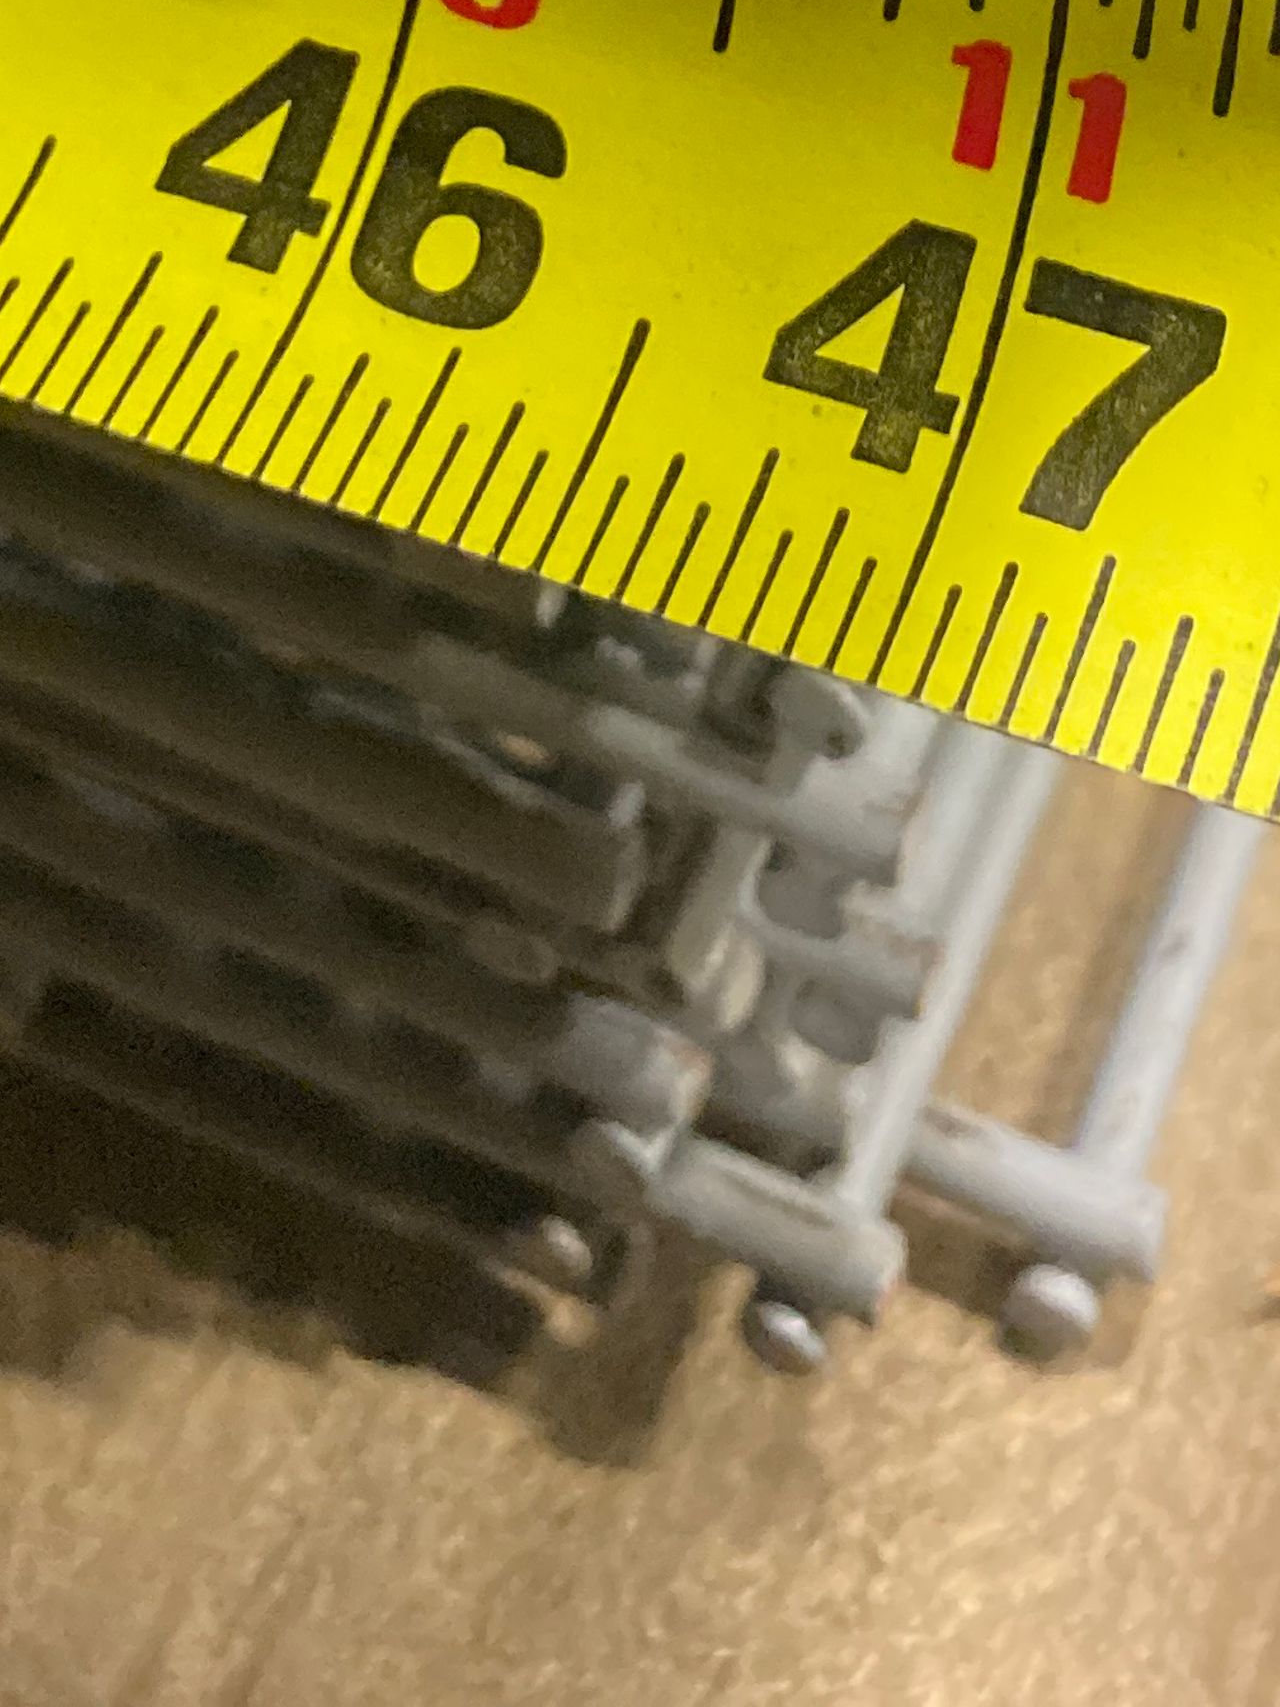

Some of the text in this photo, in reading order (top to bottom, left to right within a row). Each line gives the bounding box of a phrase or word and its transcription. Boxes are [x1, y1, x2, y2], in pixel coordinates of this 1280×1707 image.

[154, 37, 569, 333] 46
[761, 217, 1228, 533] 47
[949, 39, 1128, 204] 11
